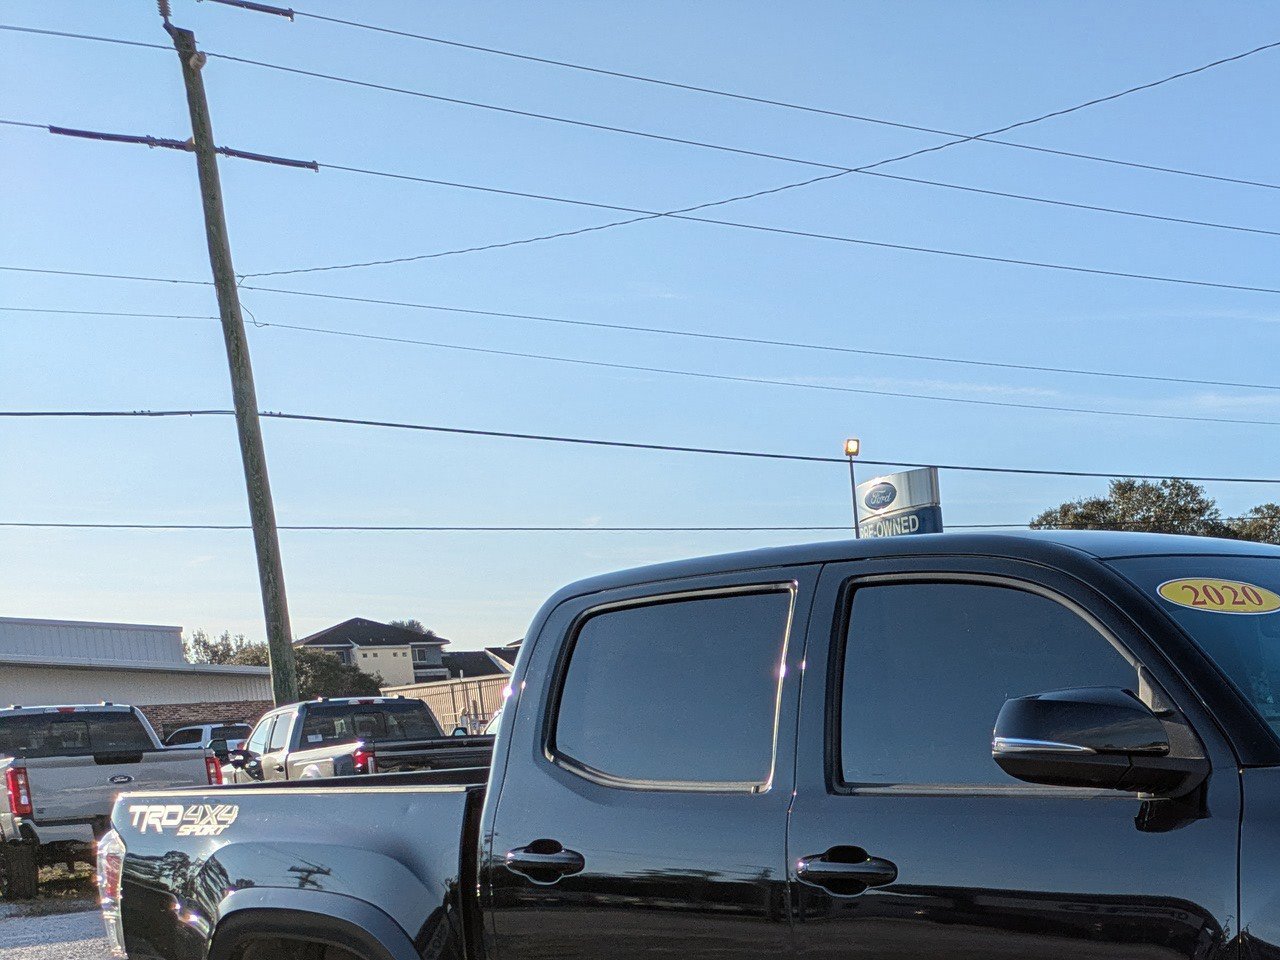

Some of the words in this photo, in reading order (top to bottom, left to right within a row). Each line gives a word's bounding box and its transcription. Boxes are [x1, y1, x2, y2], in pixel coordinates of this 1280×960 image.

[870, 489, 893, 505] Ford
[1182, 585, 1264, 606] 2020
[129, 804, 184, 835] TRD
[183, 804, 240, 826] 4X4
[176, 824, 230, 836] SPORT
